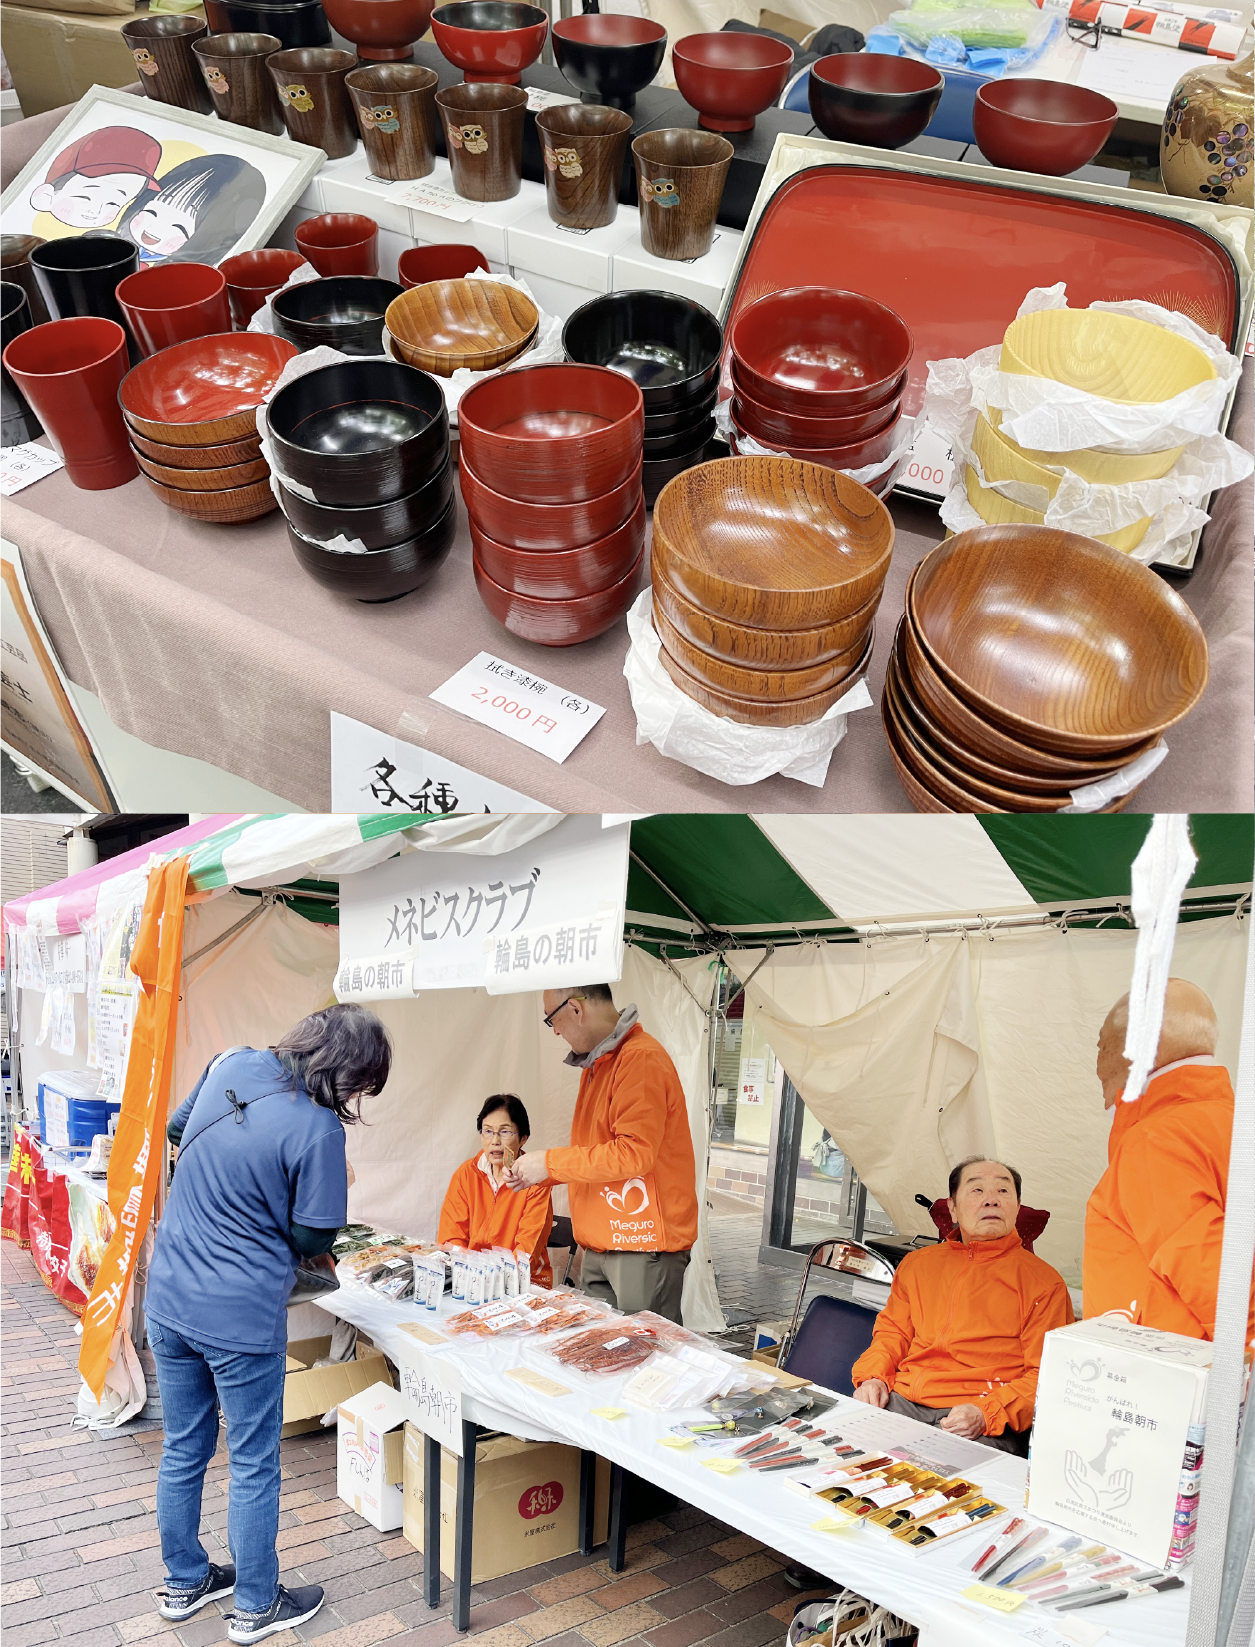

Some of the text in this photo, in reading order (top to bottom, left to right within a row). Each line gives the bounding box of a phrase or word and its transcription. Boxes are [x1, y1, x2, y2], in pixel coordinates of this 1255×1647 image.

[900, 462, 944, 485] ,000
[470, 685, 559, 736] 2,000円
[359, 756, 492, 813] 各種
[384, 866, 542, 949] メネビスクラブ
[493, 922, 603, 975] 輪島の朝市
[338, 959, 406, 994] 輪島の朝市
[609, 1219, 655, 1233] Meguro
[1064, 1387, 1100, 1404] Riverside
[1066, 1379, 1096, 1394] Meguro
[1063, 1396, 1093, 1412] Festival
[1110, 1407, 1159, 1431] 輪島朝市
